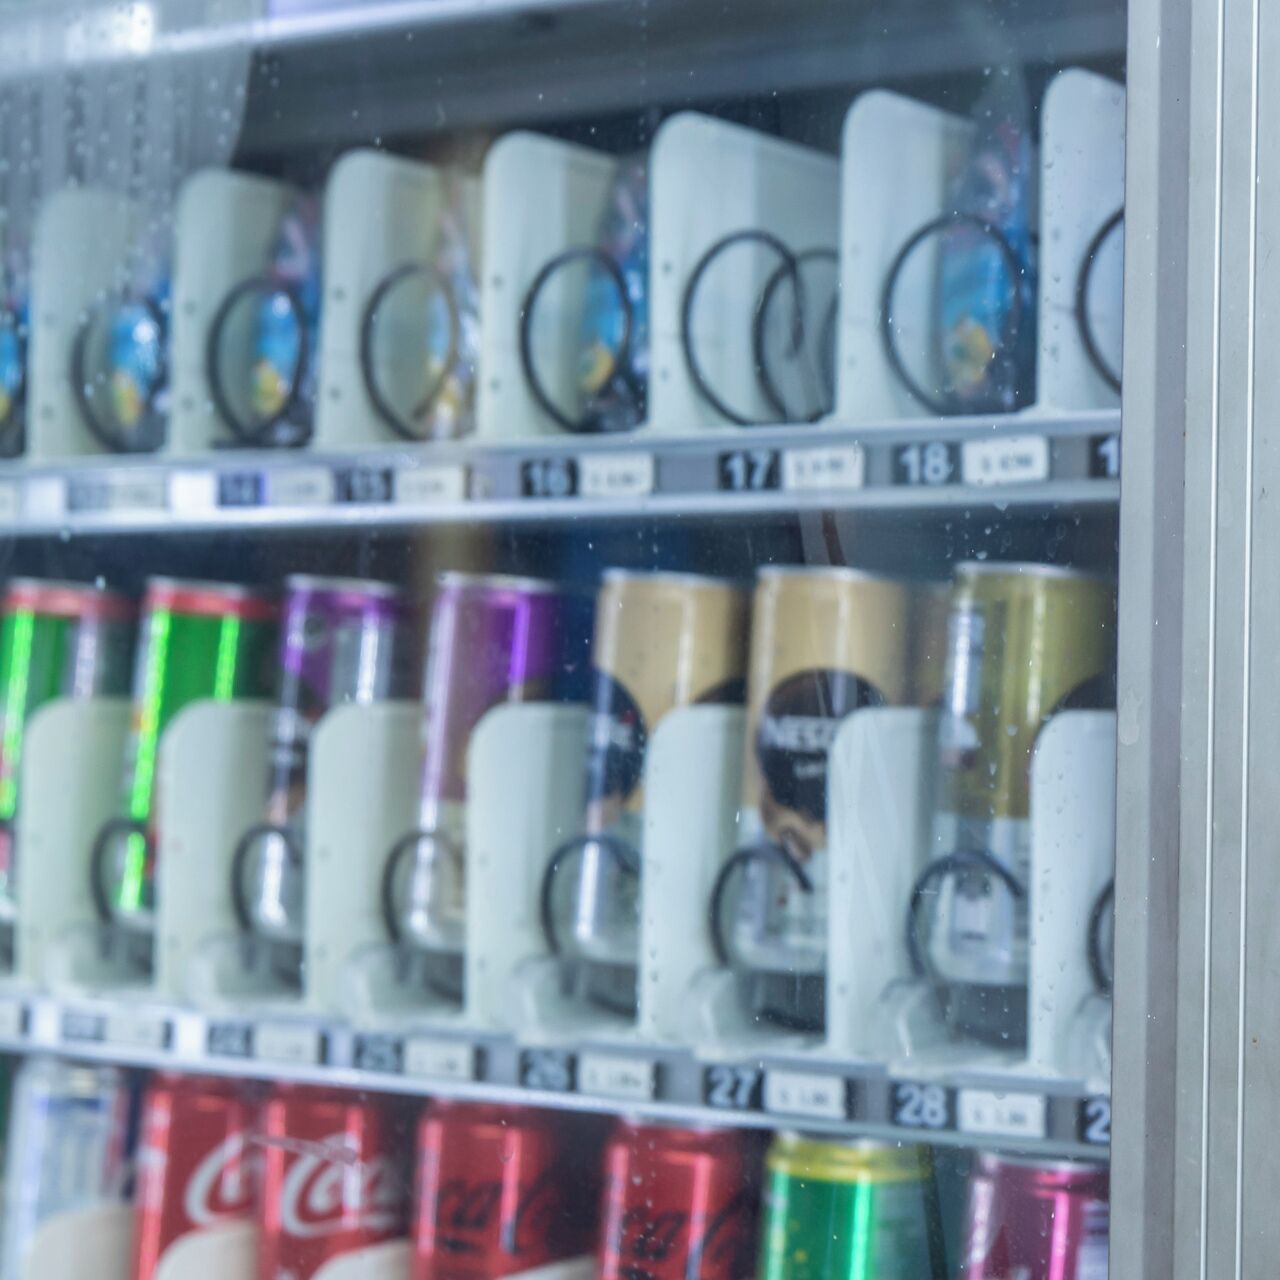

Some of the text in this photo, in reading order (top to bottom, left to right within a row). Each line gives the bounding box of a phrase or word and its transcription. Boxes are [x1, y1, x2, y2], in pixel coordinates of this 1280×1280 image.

[725, 448, 772, 490] 17
[901, 441, 949, 484] 18
[709, 1067, 756, 1107] 27
[899, 1085, 947, 1129] 28
